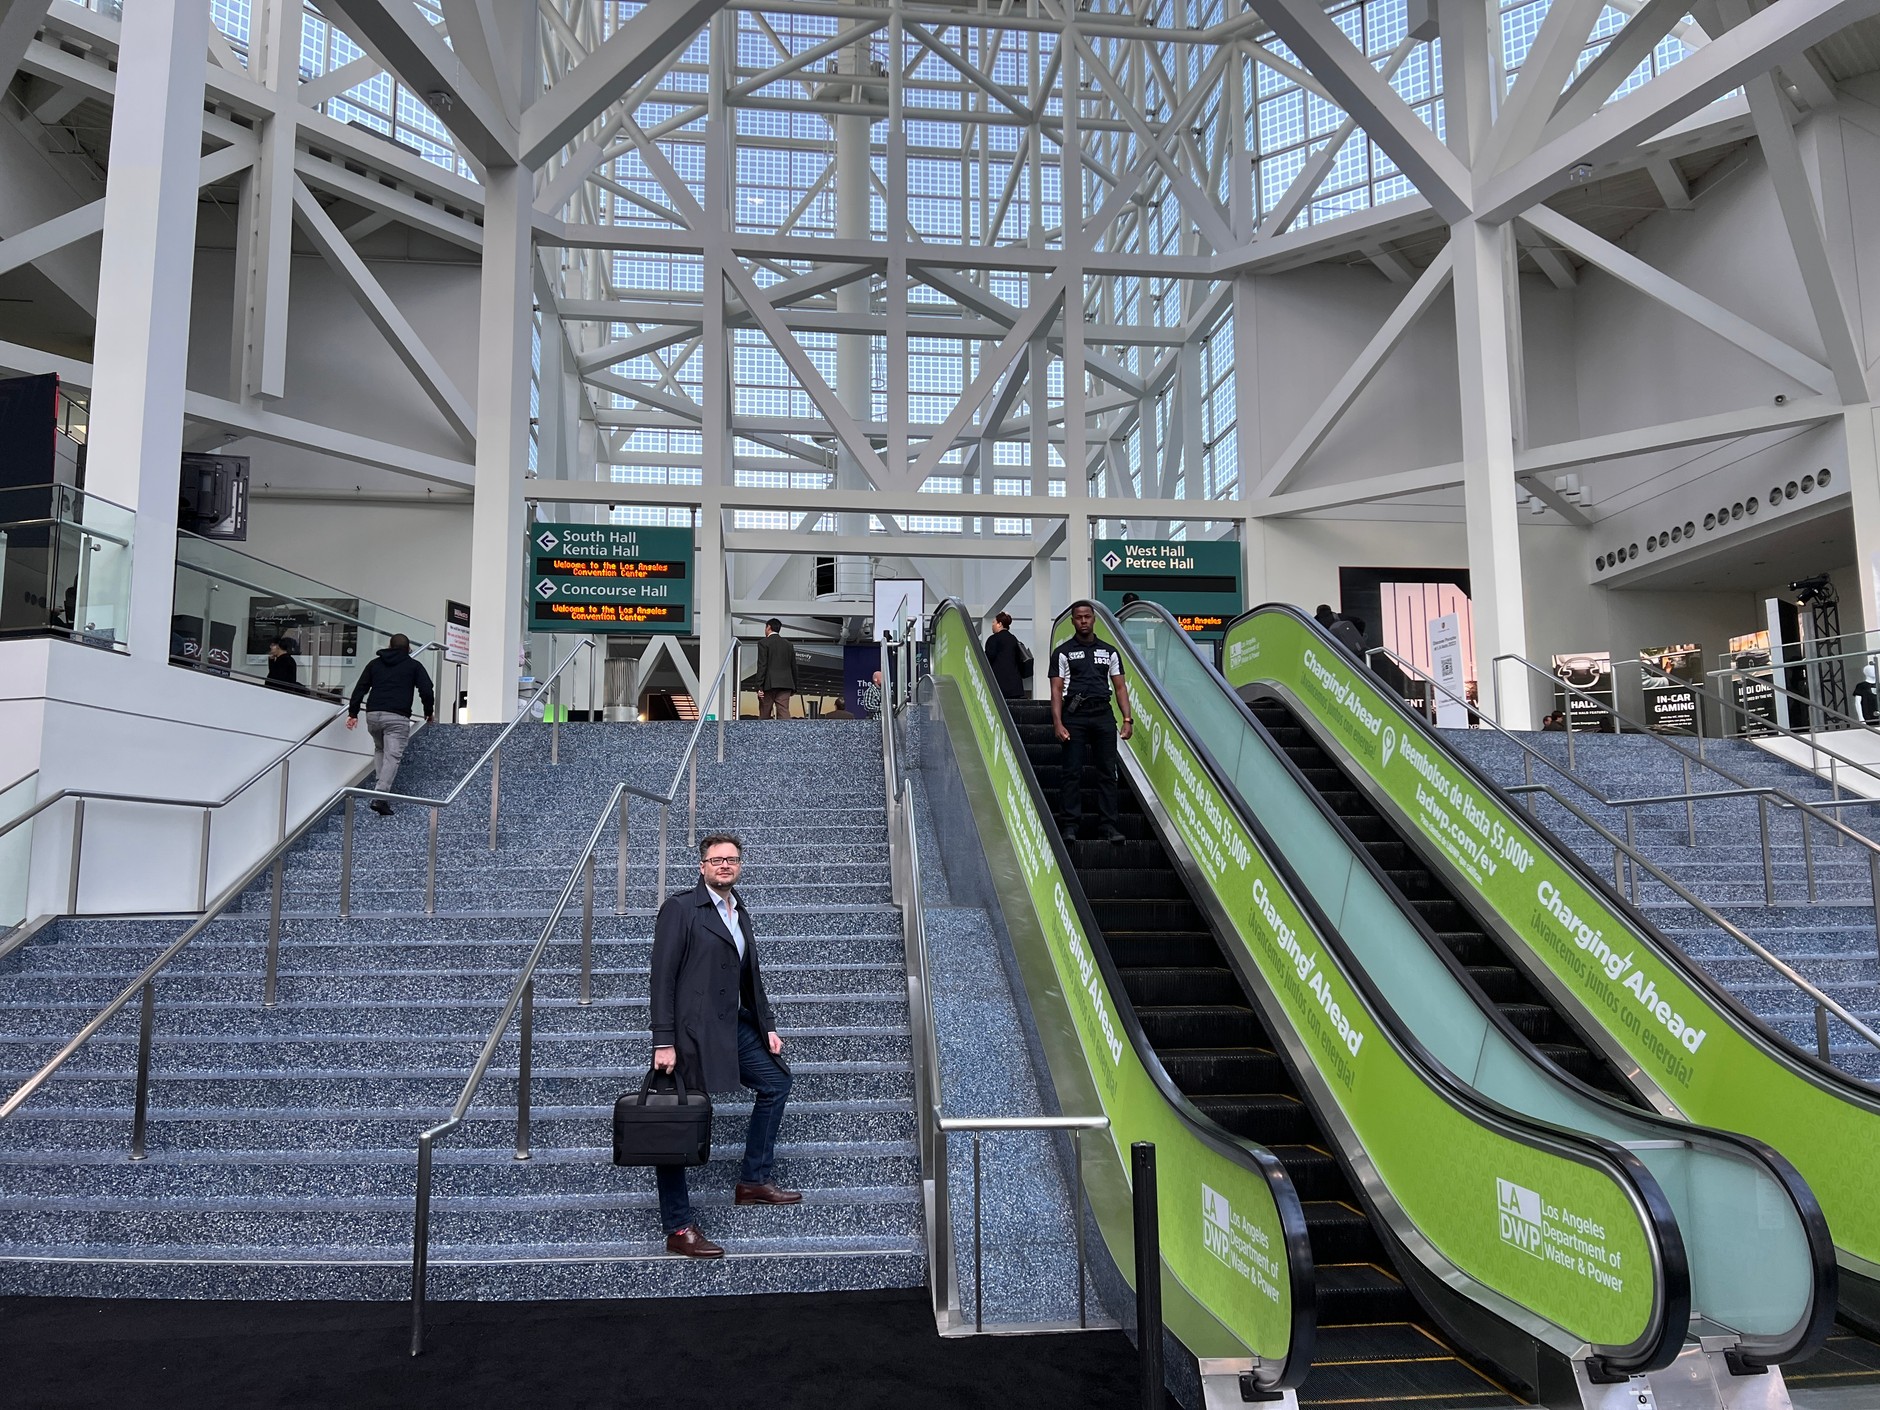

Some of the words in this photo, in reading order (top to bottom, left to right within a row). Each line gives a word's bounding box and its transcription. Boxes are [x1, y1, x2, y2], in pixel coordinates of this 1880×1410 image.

[563, 530, 605, 543] South
[610, 531, 636, 544] Hall
[563, 544, 608, 557] Kentia
[612, 545, 639, 557] Hall
[1125, 545, 1157, 557] West
[1161, 546, 1185, 557] Hall
[553, 560, 586, 570] Welcome
[590, 562, 599, 570] to
[603, 562, 616, 570] the
[620, 563, 634, 571] Los
[638, 563, 668, 572] Angeles
[573, 568, 617, 577] Convention
[621, 569, 648, 578] Center
[1126, 557, 1166, 569] Petree
[1170, 558, 1194, 569] Hall
[552, 604, 585, 614] Welcome
[589, 606, 598, 614] to
[601, 606, 615, 614] the
[619, 606, 633, 614] Los
[637, 607, 667, 615] Angeles
[561, 583, 636, 597] Concourse
[641, 585, 667, 597] Hall
[572, 612, 616, 621] Convention
[620, 613, 647, 622] Center
[1178, 616, 1193, 625] Los
[1195, 617, 1222, 625] Angeles
[1179, 623, 1204, 631] Center
[1129, 687, 1152, 732] Ahead
[1304, 649, 1345, 704] Charging
[1344, 692, 1382, 736] Ahead
[1654, 702, 1695, 713] GAMING
[1657, 693, 1691, 703] IN-CAR
[1163, 729, 1196, 794] Reembolsos
[1195, 779, 1205, 802] de
[1203, 790, 1223, 835] Hasta
[1400, 733, 1450, 798] Reembolsos
[1450, 784, 1463, 811] de
[1462, 794, 1491, 838] Hasta
[1173, 779, 1227, 874] ladwp.com/ev
[1416, 783, 1497, 877] ladwp.com/ev
[1054, 882, 1090, 987] Charging
[1088, 977, 1123, 1067] Ahead
[1252, 878, 1309, 982] Charging
[1308, 971, 1364, 1057] Ahead
[1537, 880, 1622, 980] Charging
[1622, 970, 1707, 1054] Ahead
[1530, 909, 1586, 979] ¡Avancemos
[1585, 967, 1620, 1014] juntos
[1620, 1004, 1641, 1037] con
[1641, 1028, 1694, 1089] energía!
[1284, 967, 1307, 1011] juntos
[1307, 1007, 1321, 1039] con
[1321, 1030, 1355, 1093] energía!
[1203, 1187, 1218, 1221] LA
[1499, 1181, 1521, 1214] LA
[1204, 1219, 1229, 1260] DWP
[1229, 1205, 1240, 1229] Los
[1242, 1216, 1269, 1249] Angeles
[1500, 1212, 1540, 1252] DWP
[1541, 1198, 1559, 1221] Los
[1562, 1208, 1606, 1240] Angeles
[1229, 1228, 1270, 1273] Department
[1270, 1262, 1278, 1280] of
[1543, 1220, 1606, 1263] Department
[1609, 1252, 1621, 1269] of
[1230, 1249, 1250, 1279] Water
[1250, 1266, 1257, 1286] &
[1257, 1271, 1280, 1304] Power
[1544, 1242, 1576, 1271] Water
[1577, 1257, 1586, 1276] &
[1587, 1261, 1623, 1293] Power
